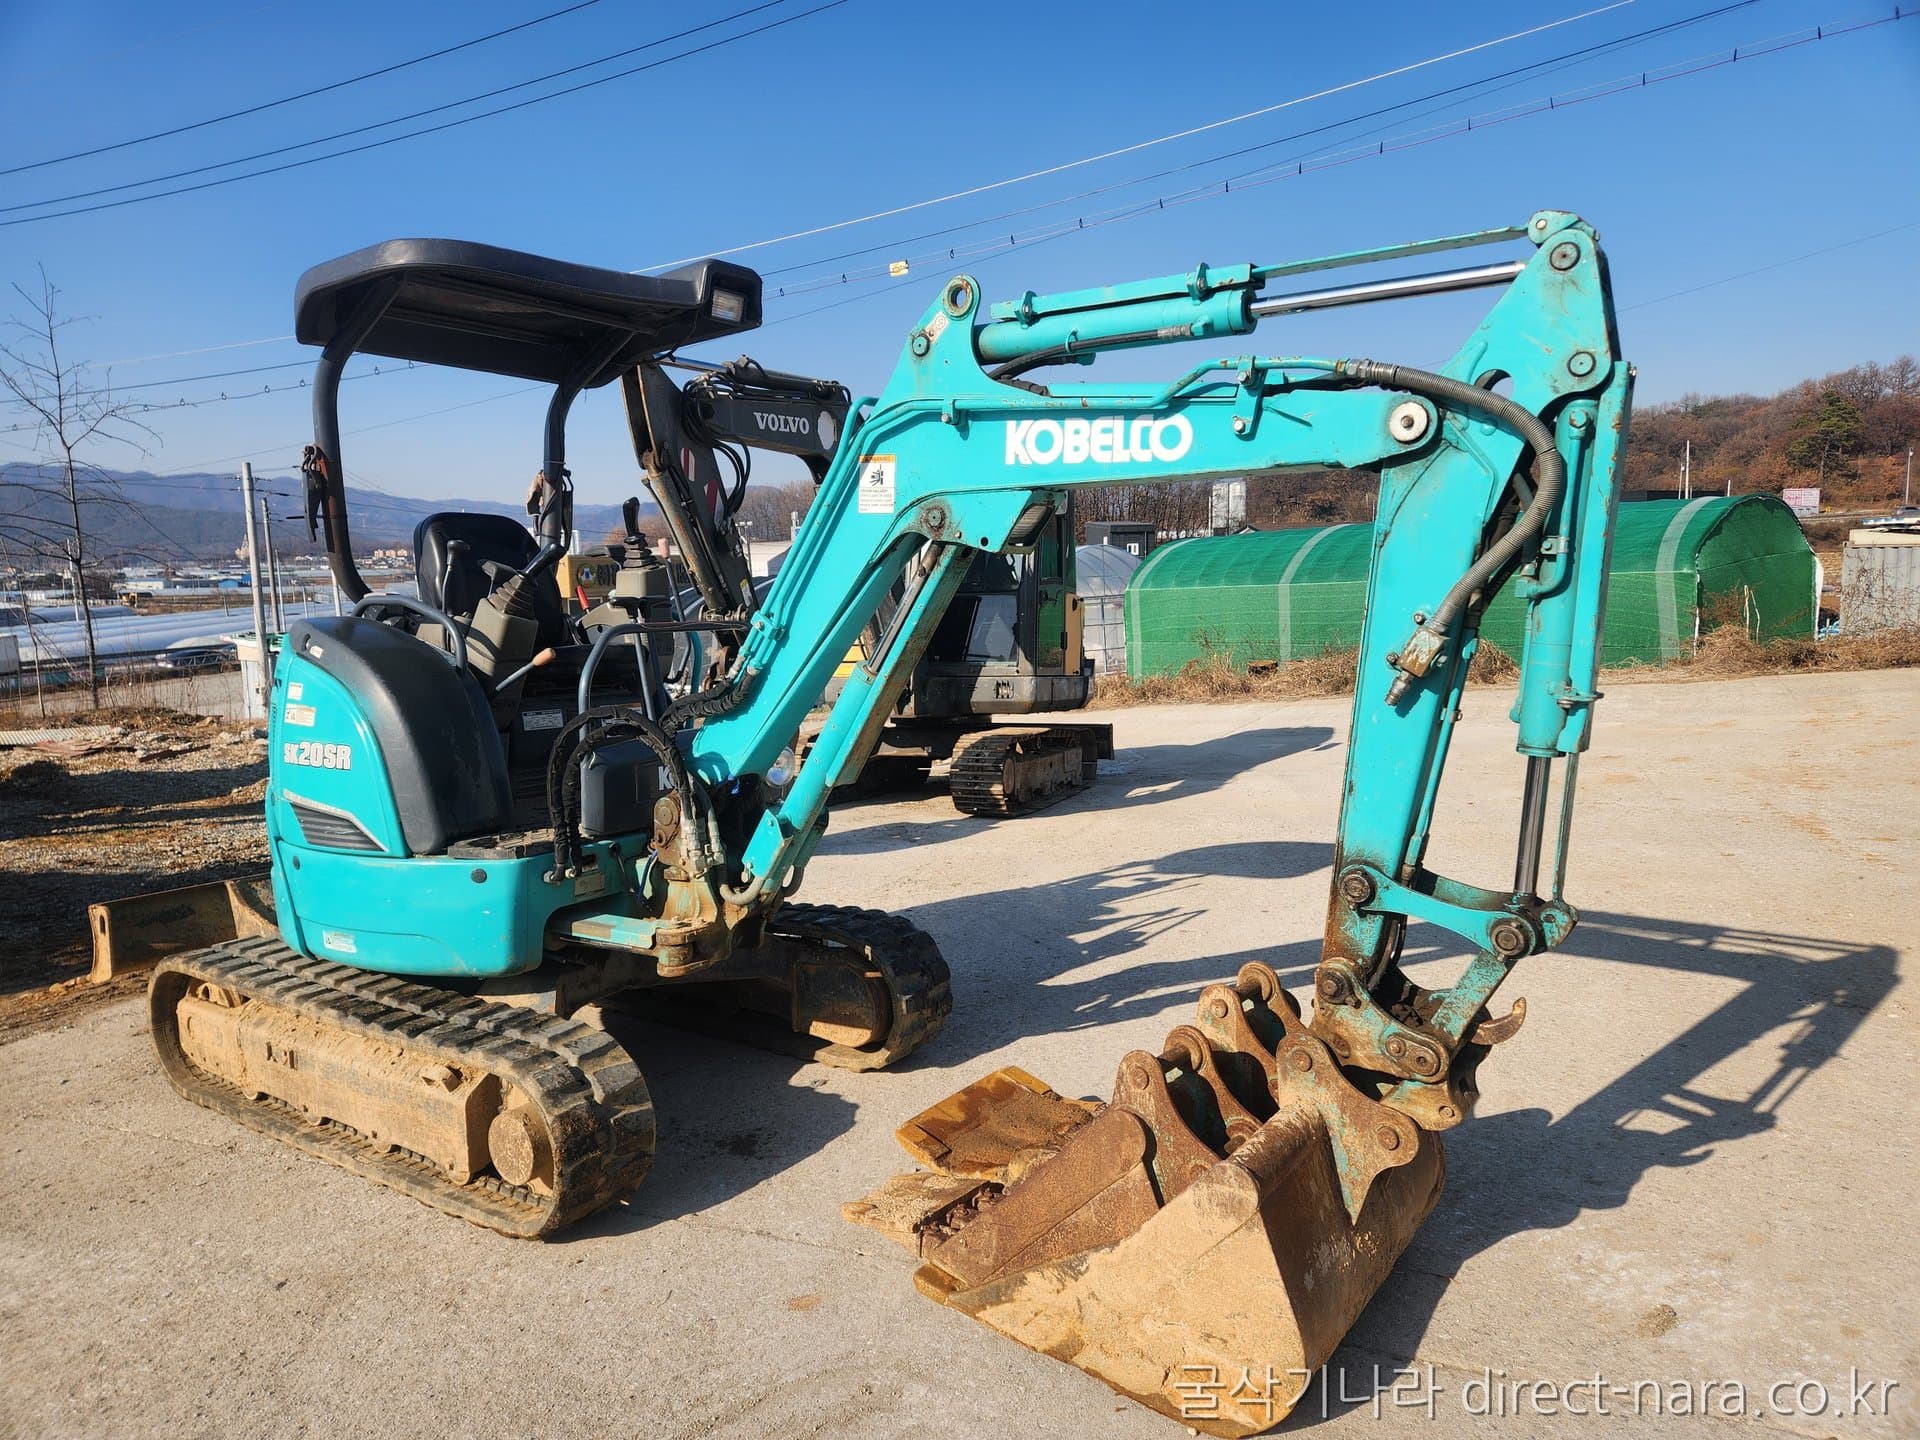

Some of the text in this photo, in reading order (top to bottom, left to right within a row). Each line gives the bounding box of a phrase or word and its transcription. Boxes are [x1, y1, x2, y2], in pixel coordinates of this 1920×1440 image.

[753, 411, 810, 435] VOLVO
[1005, 413, 1194, 465] KOBELCO
[283, 741, 352, 770] SK20SR
